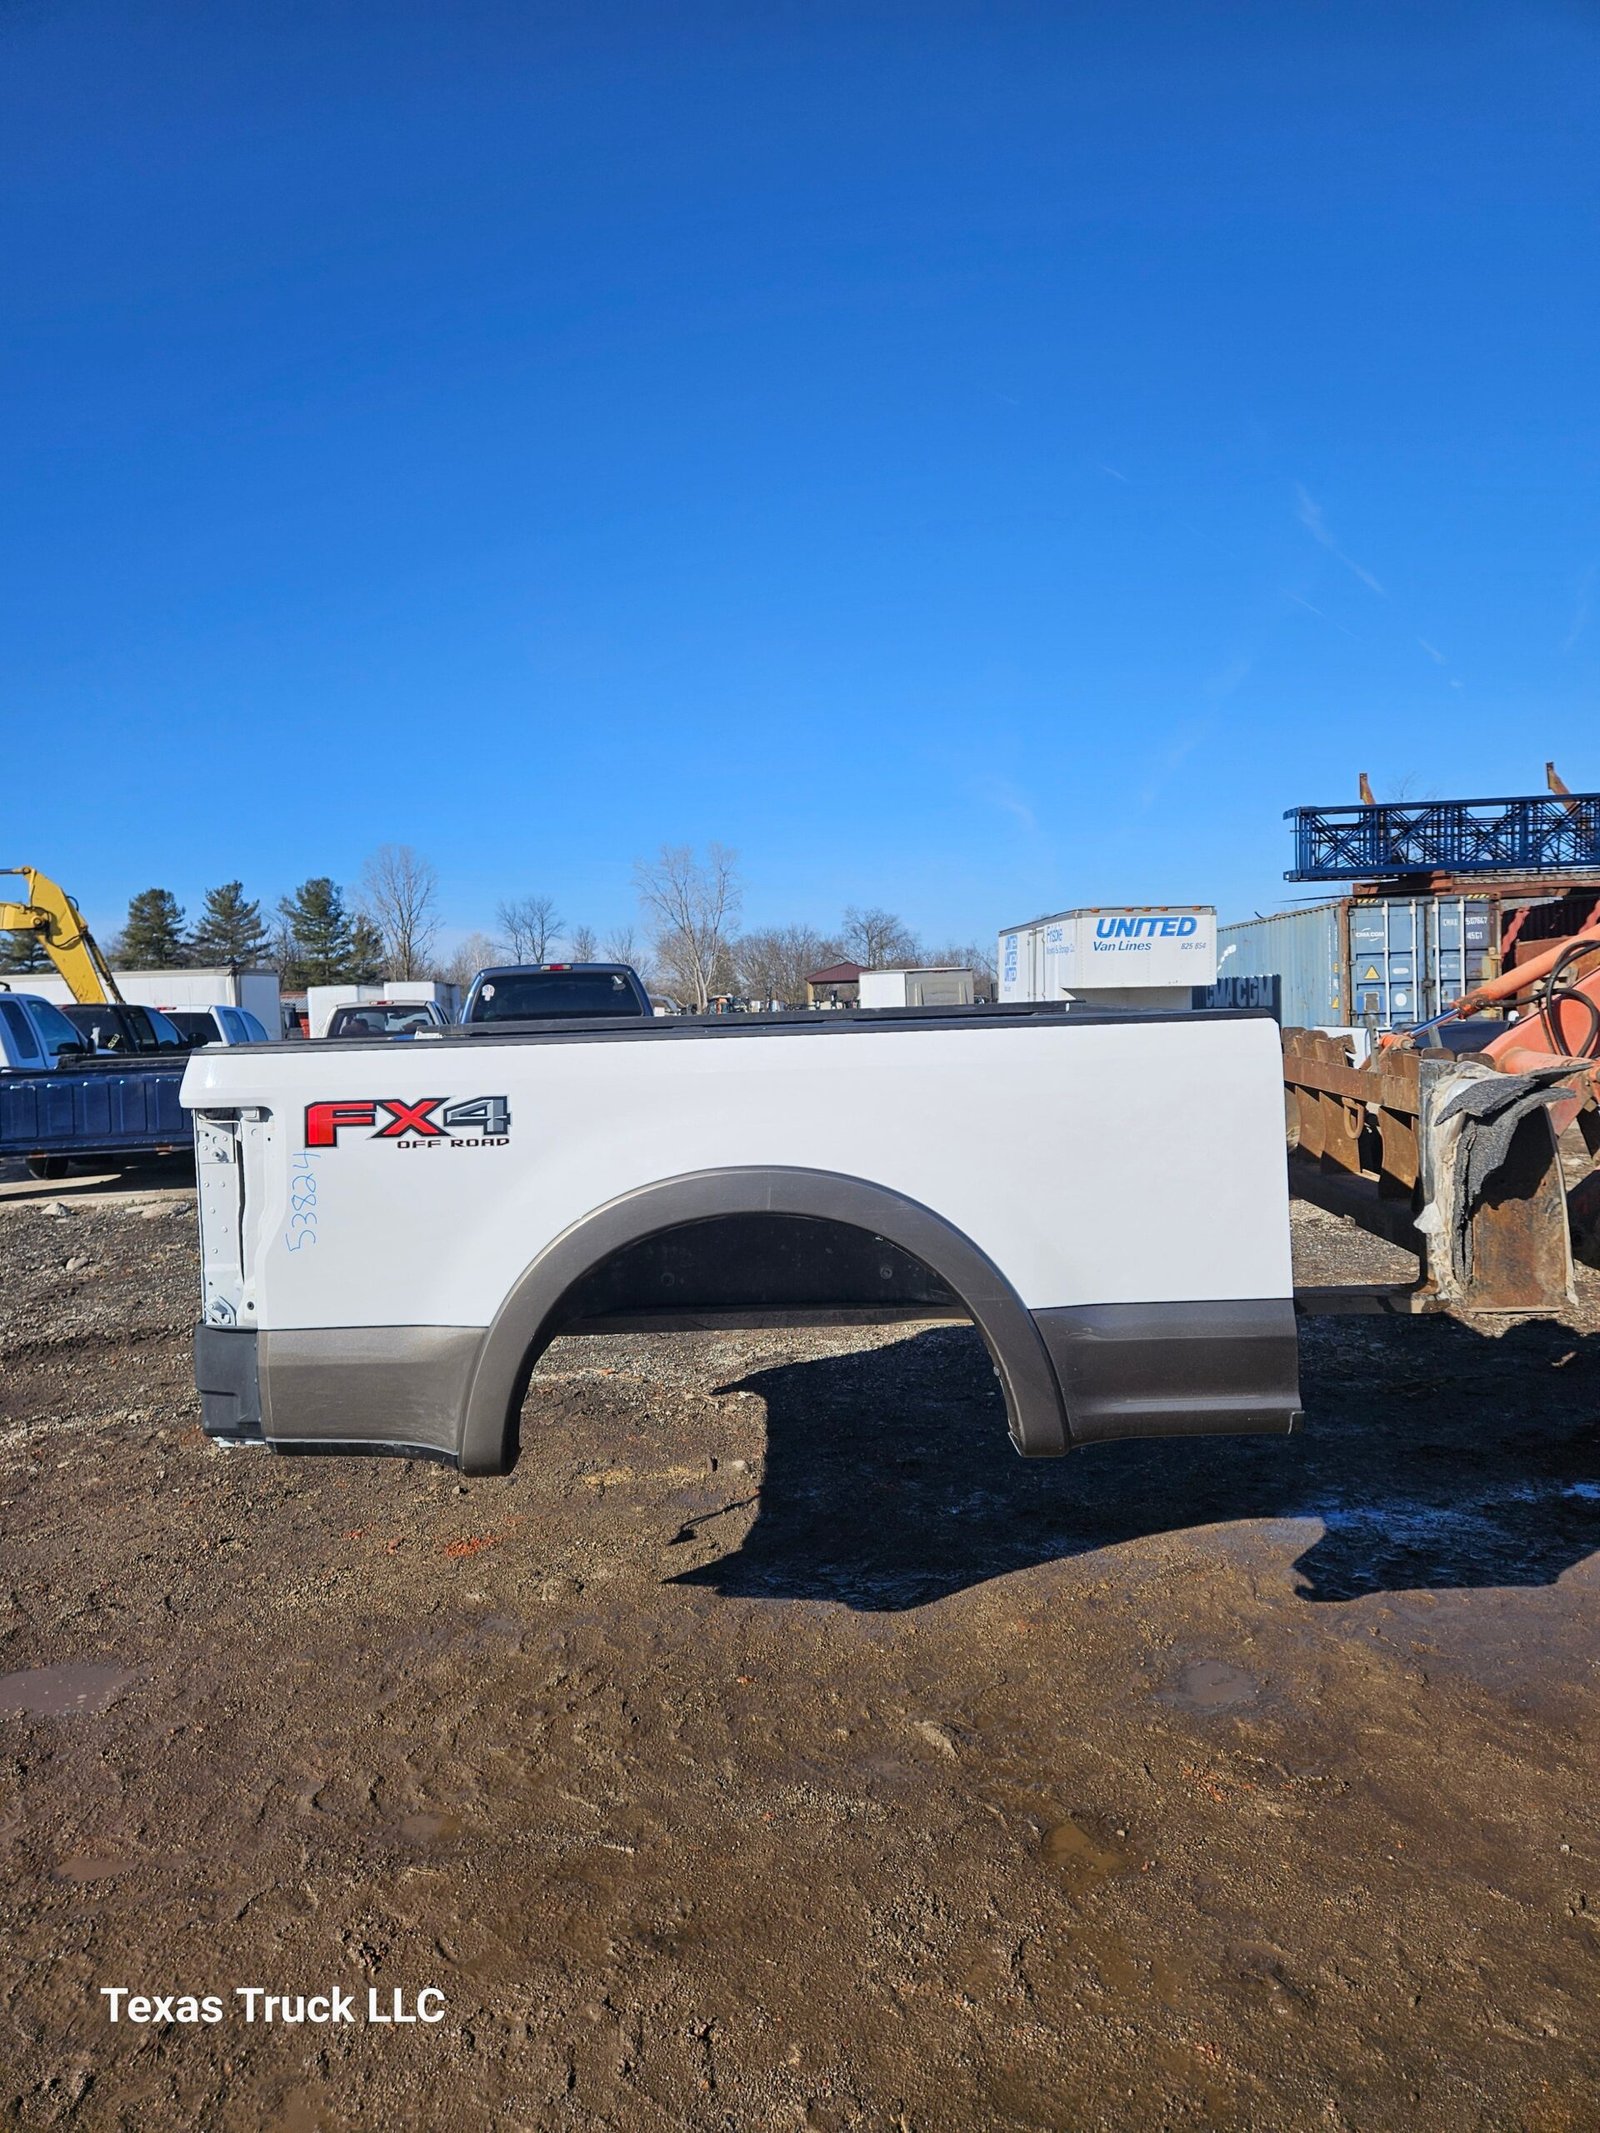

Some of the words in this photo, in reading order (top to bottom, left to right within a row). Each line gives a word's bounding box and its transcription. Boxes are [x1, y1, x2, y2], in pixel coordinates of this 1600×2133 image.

[1096, 916, 1198, 938] UNITED
[1093, 941, 1116, 951] Van
[1118, 940, 1152, 951] Lines
[1236, 976, 1273, 1007] CGM
[304, 1096, 511, 1148] FX4
[396, 1139, 442, 1149] OFF
[450, 1137, 510, 1148] ROAD
[286, 1151, 321, 1252] 53824
